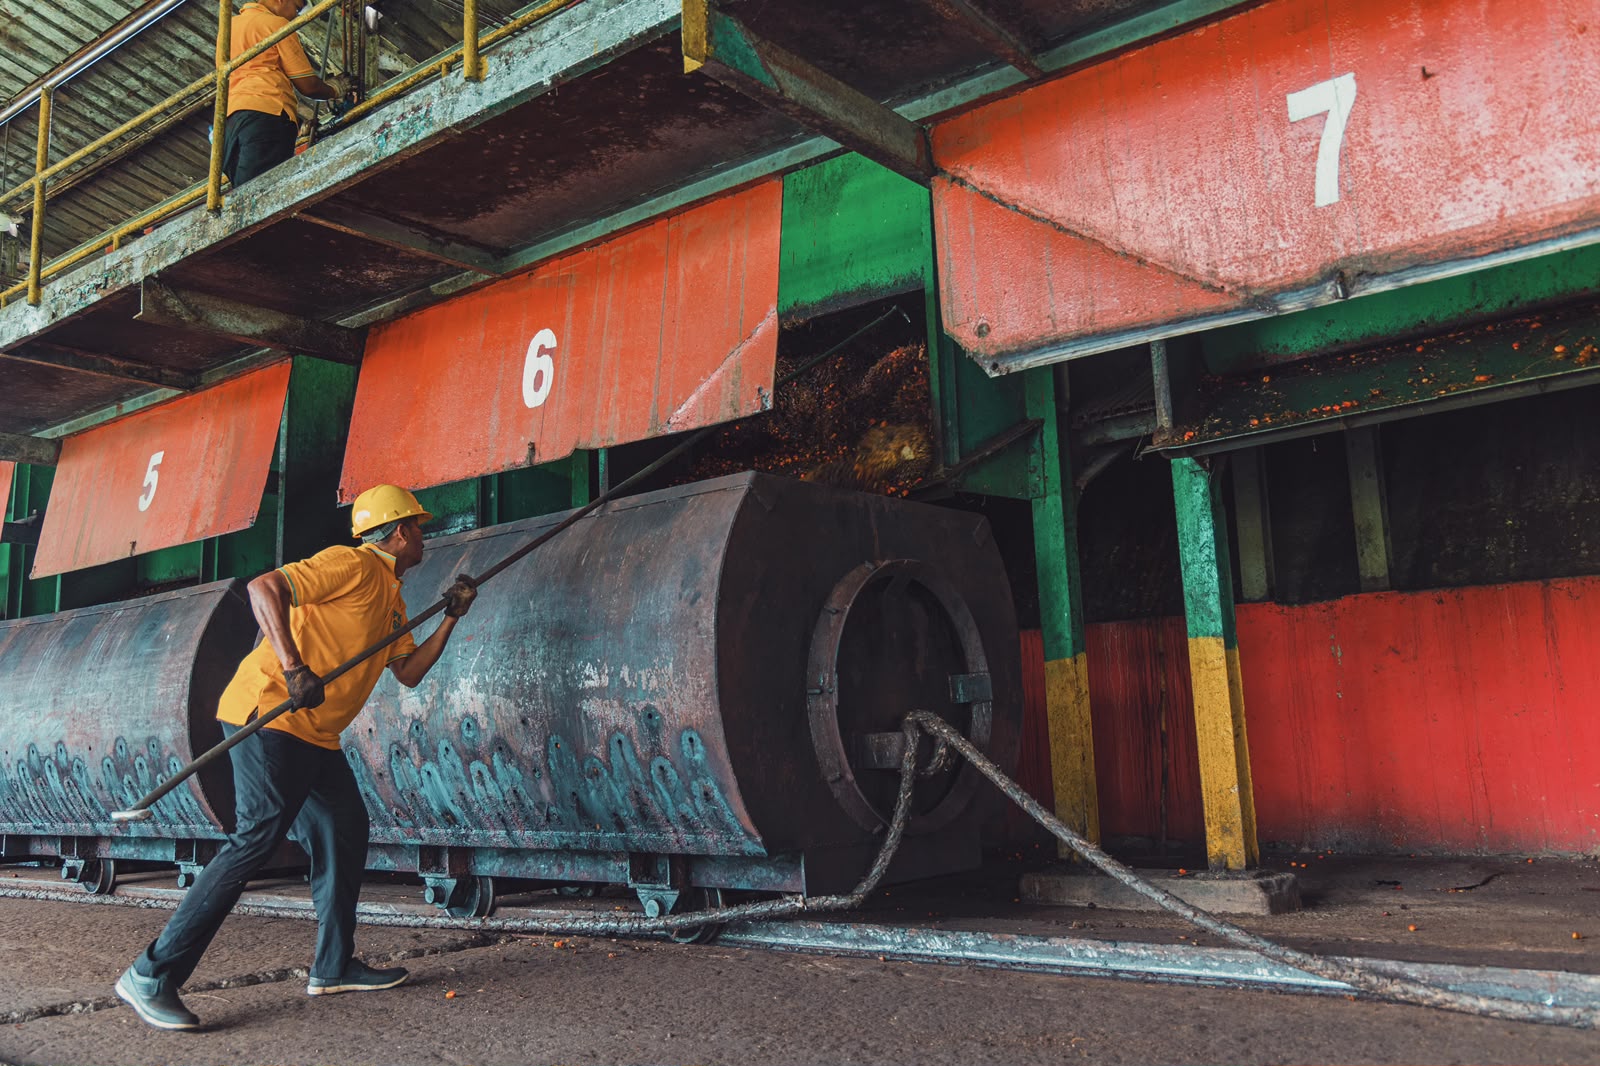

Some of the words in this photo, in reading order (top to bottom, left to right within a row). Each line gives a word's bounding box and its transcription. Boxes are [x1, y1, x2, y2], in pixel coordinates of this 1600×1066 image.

[1286, 72, 1357, 208] 7
[522, 328, 557, 408] 6
[138, 450, 164, 512] 5
